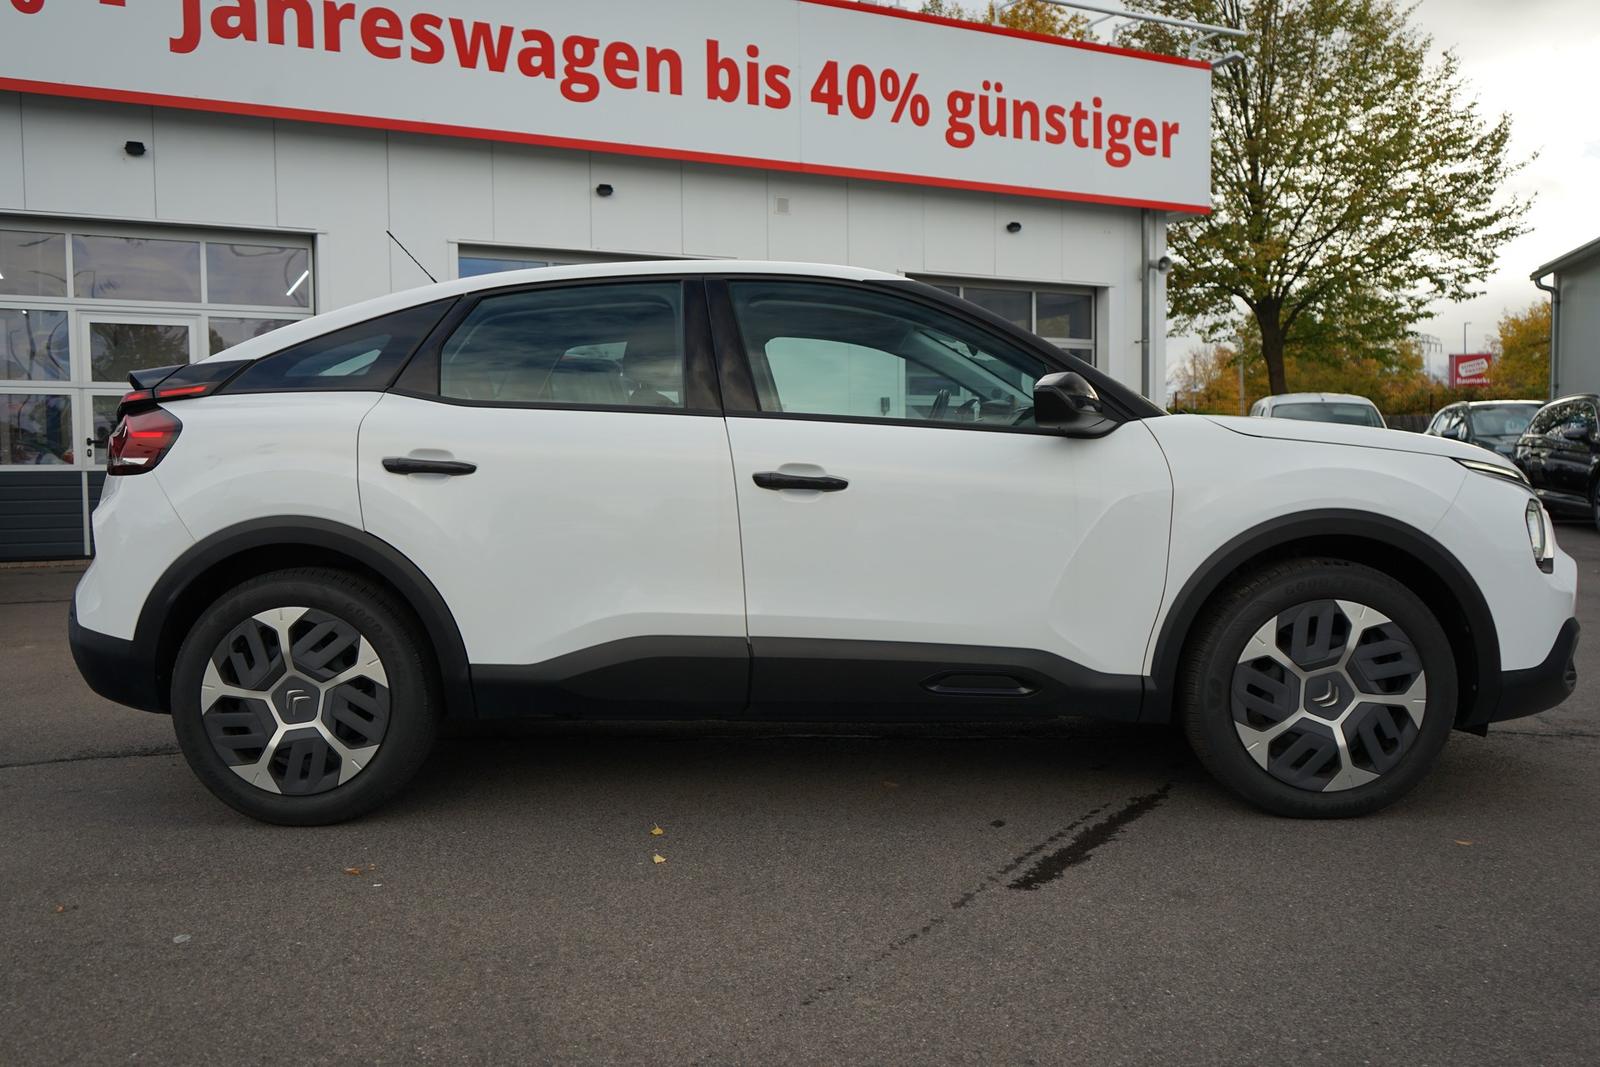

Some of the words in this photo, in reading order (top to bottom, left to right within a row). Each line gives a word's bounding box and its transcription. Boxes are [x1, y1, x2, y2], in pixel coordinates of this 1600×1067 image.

[169, 0, 683, 103] Jahreswagen
[706, 39, 792, 110] bis
[810, 60, 930, 128] 40%
[945, 80, 1180, 169] günstiger
